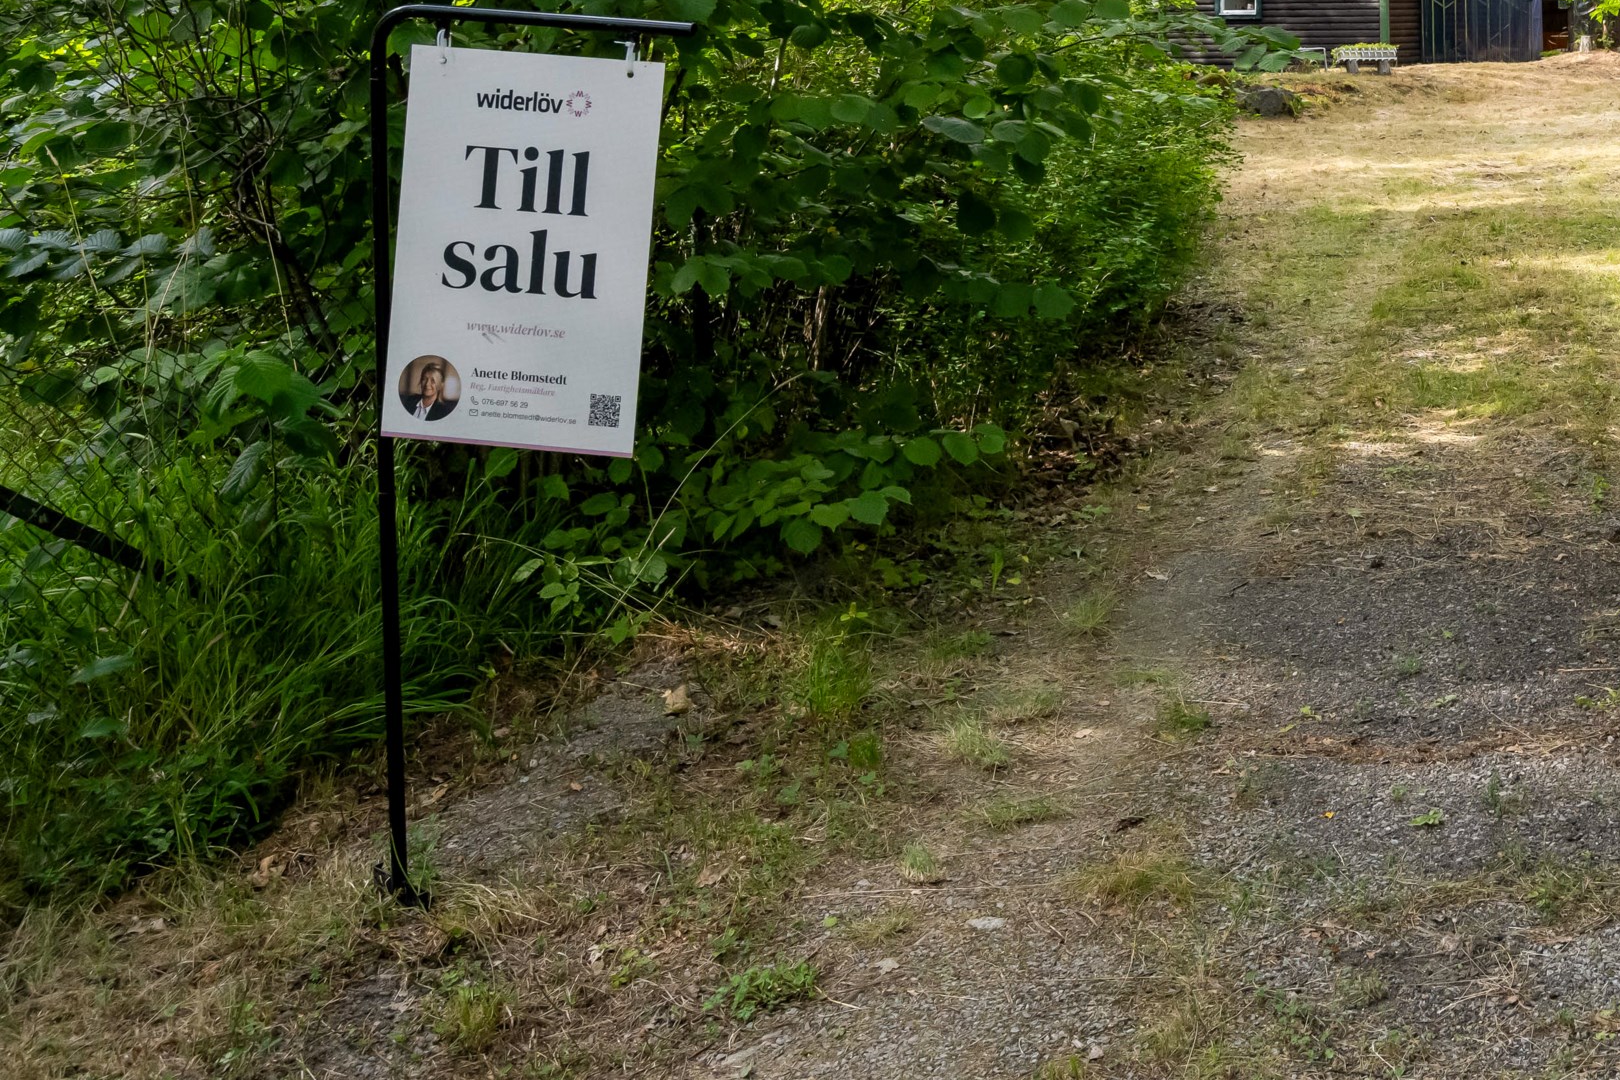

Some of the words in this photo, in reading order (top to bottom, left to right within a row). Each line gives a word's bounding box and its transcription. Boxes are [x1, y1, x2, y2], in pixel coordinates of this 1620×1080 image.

[476, 88, 563, 114] widerlöv
[464, 145, 590, 217] Till
[441, 229, 598, 299] salu
[467, 322, 566, 338] www.widerlov.se
[471, 368, 508, 380] Anette
[511, 371, 567, 385] Blomstedt
